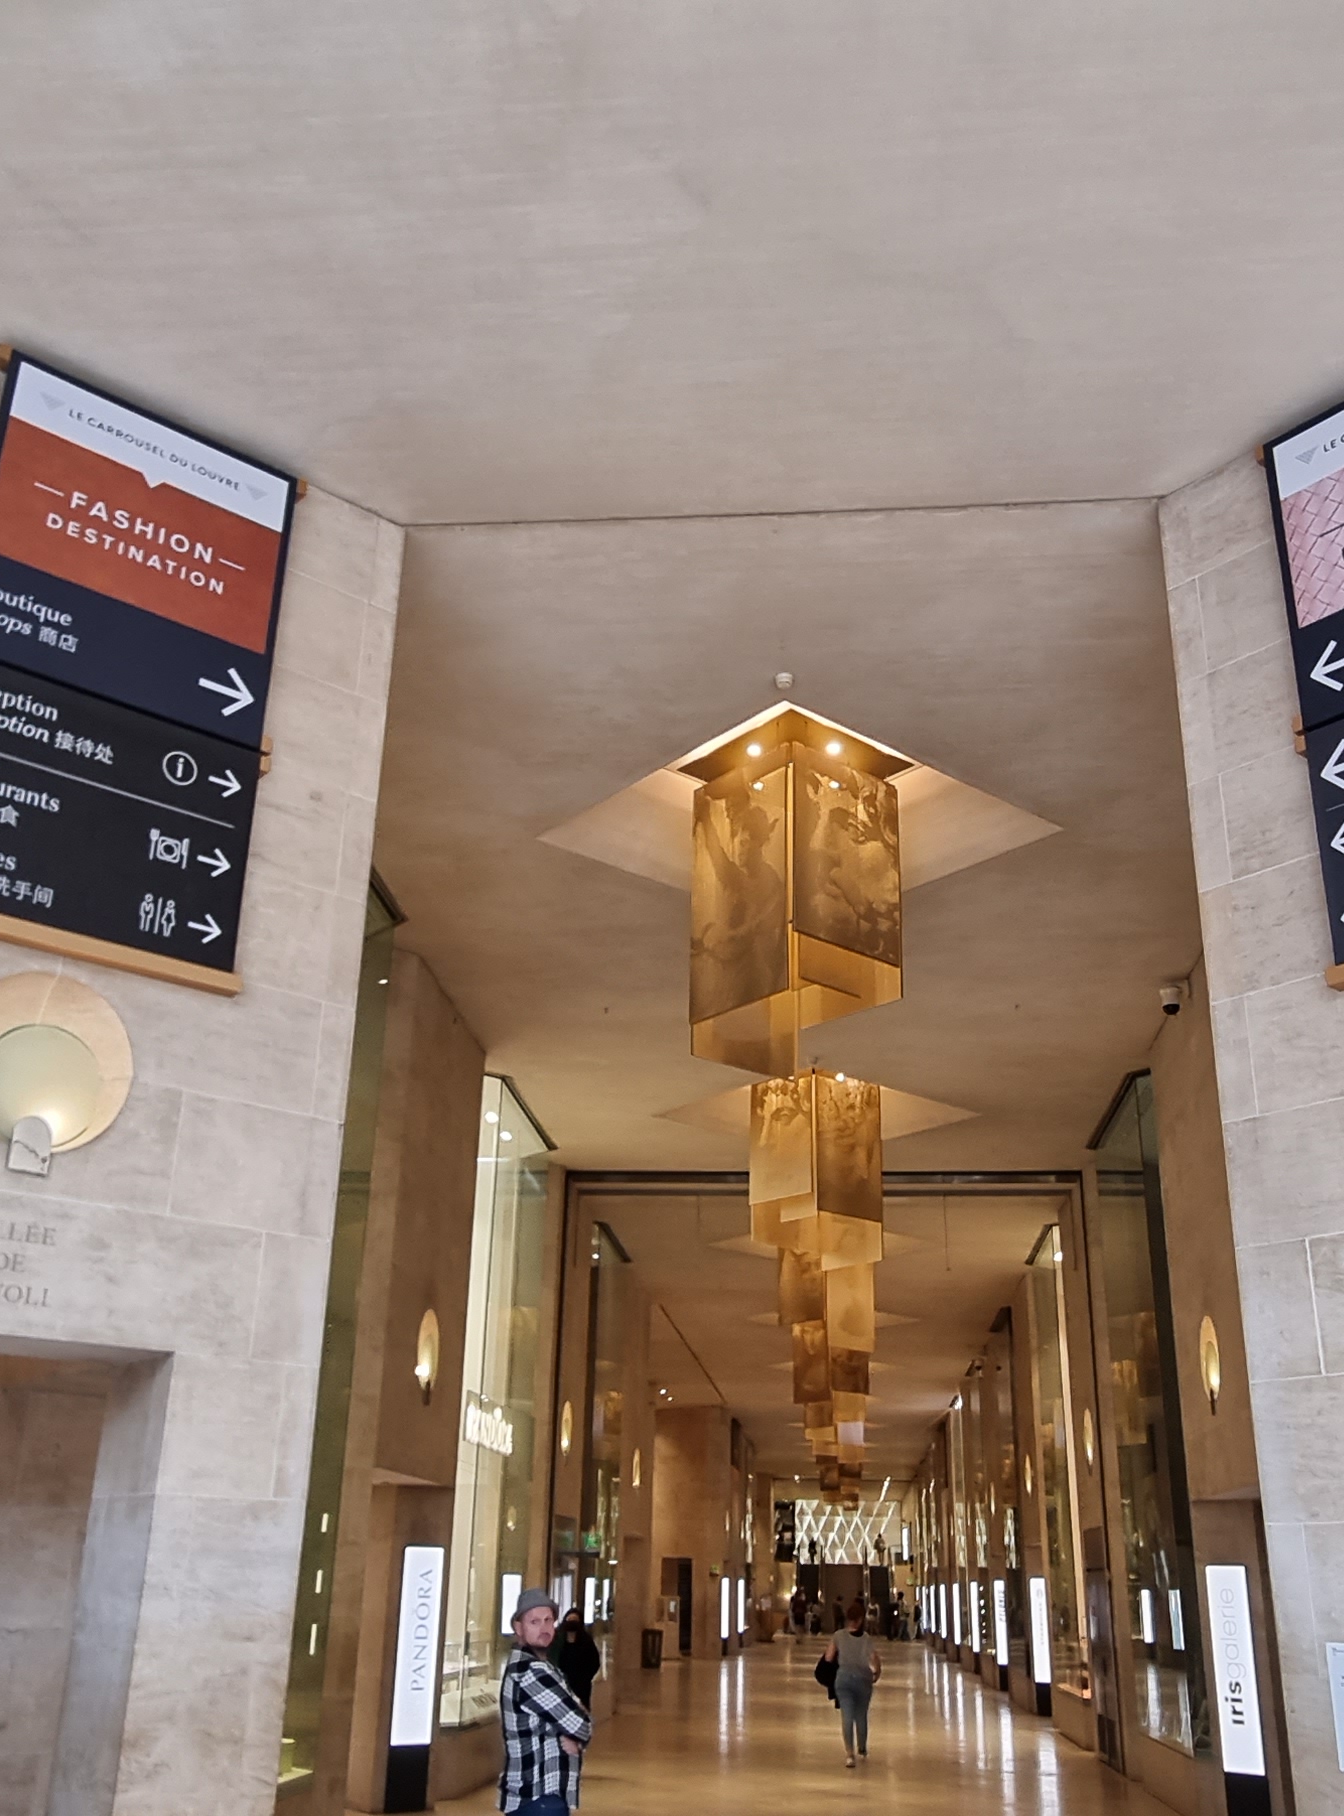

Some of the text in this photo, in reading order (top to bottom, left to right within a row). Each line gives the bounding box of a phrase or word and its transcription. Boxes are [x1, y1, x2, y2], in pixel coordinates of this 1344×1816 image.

[68, 408, 240, 492] LE CARROUSEL DU LOUVRE
[1323, 441, 1338, 453] LE
[46, 513, 225, 595] DESTINATION
[70, 491, 214, 564] FASHION
[38, 626, 79, 653] 商店
[54, 729, 115, 766] 接待处
[411, 1568, 433, 1691] PANDORA
